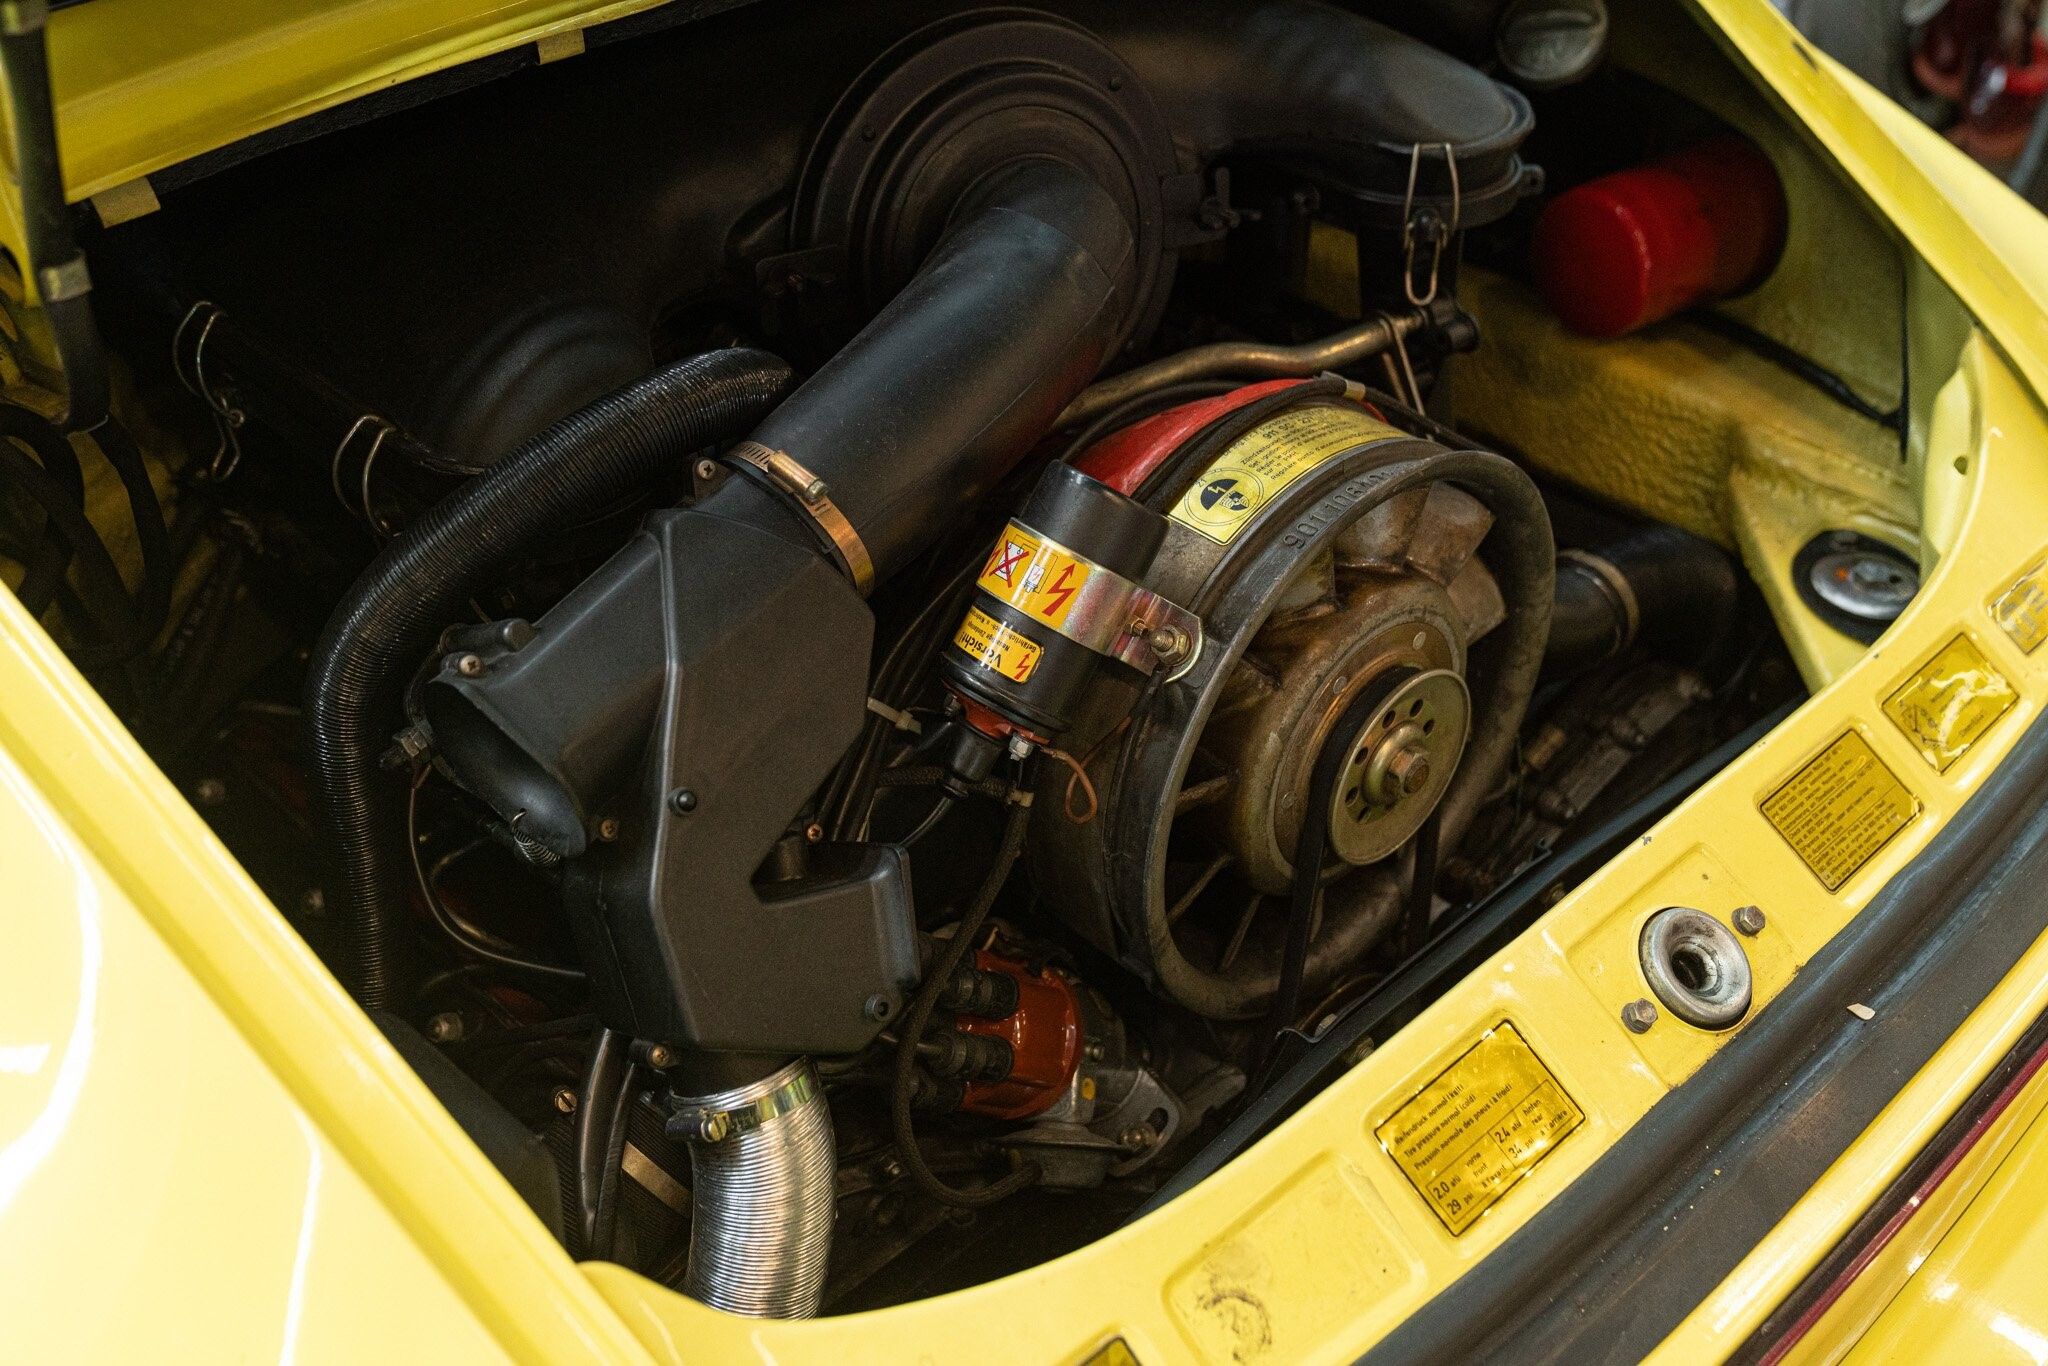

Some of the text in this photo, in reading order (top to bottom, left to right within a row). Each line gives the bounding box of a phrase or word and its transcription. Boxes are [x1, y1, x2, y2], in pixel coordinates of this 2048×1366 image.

[958, 631, 1002, 668] Vorsicht!
[1426, 1096, 1448, 1117] normal
[1462, 1116, 1474, 1129] des
[1473, 1102, 1491, 1120] pneus
[1522, 1097, 1541, 1115] hinten
[1404, 1093, 1476, 1157] Tire pressure normal (cold)
[1531, 1113, 1543, 1126] rear
[1508, 1143, 1522, 1159] 34
[1472, 1162, 1488, 1177] front
[1446, 1191, 1474, 1215] 29 psi
